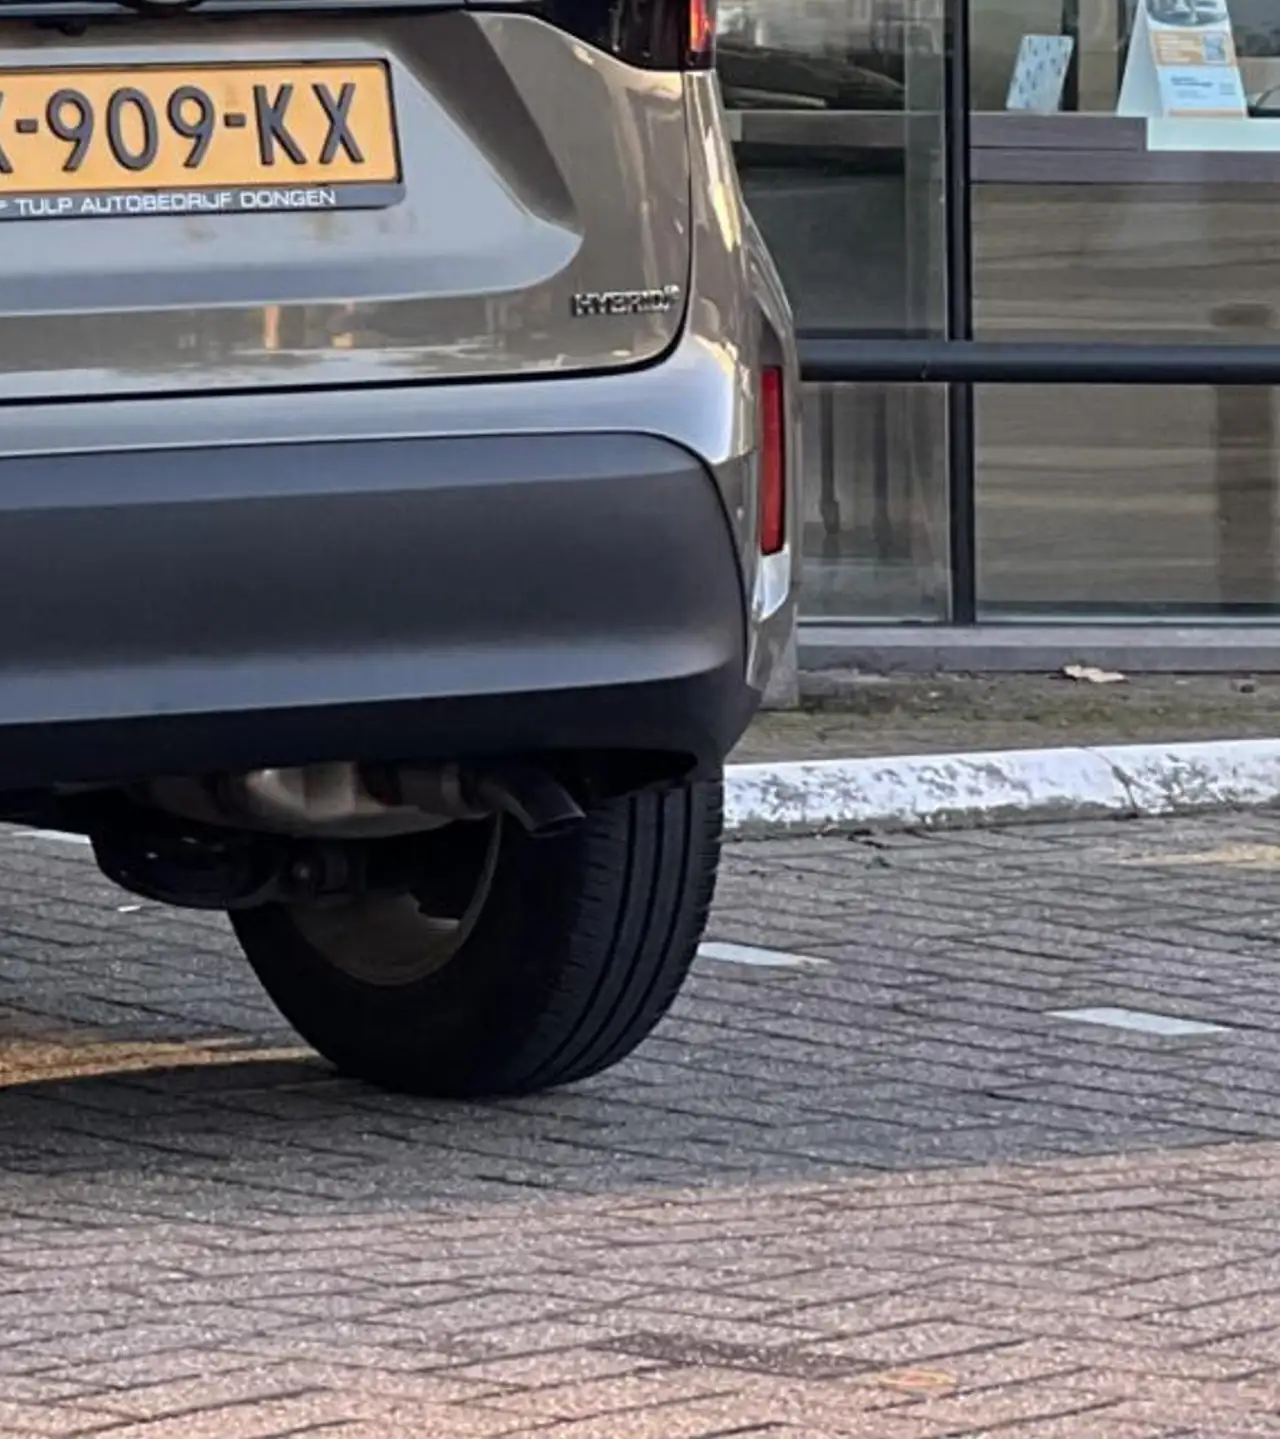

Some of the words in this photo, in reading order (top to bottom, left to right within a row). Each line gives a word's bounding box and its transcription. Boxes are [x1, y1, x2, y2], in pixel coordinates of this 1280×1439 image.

[14, 198, 73, 217] TULP
[80, 191, 234, 213] AUTOBEDRIJF
[240, 189, 336, 209] DONGEN
